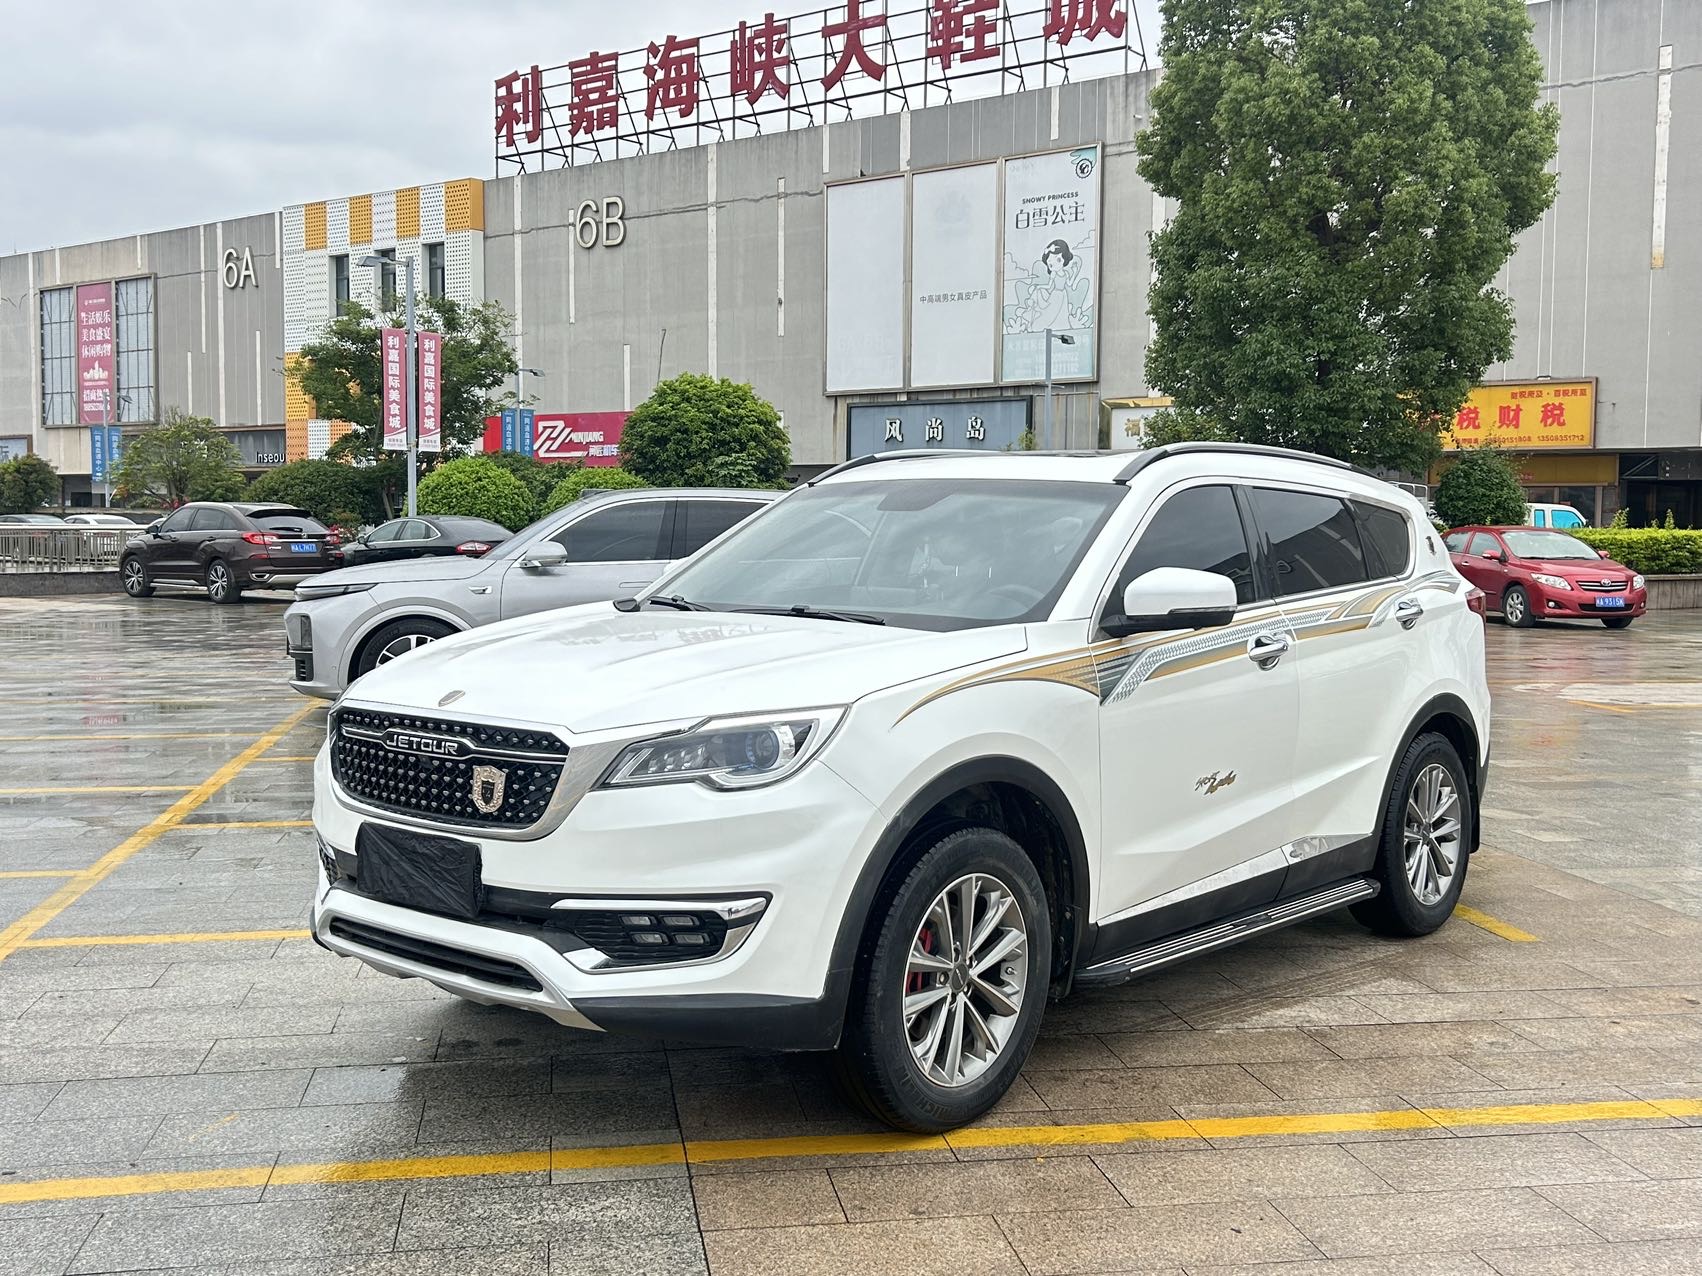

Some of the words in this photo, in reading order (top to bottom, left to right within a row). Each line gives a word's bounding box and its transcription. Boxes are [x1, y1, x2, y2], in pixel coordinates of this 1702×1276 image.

[1022, 196, 1046, 204] SNOWY
[1048, 191, 1079, 201] PRINCESS
[576, 196, 625, 249] 6B
[1015, 200, 1085, 230] 白雪公主
[223, 247, 257, 289] 6A
[919, 289, 988, 304] 中高端男女真皮产品
[387, 335, 401, 429] 利嘉国际美食城
[423, 338, 436, 430] 利嘉国际美食城
[884, 416, 986, 442] 风尚岛
[386, 734, 458, 755] JETOUR
